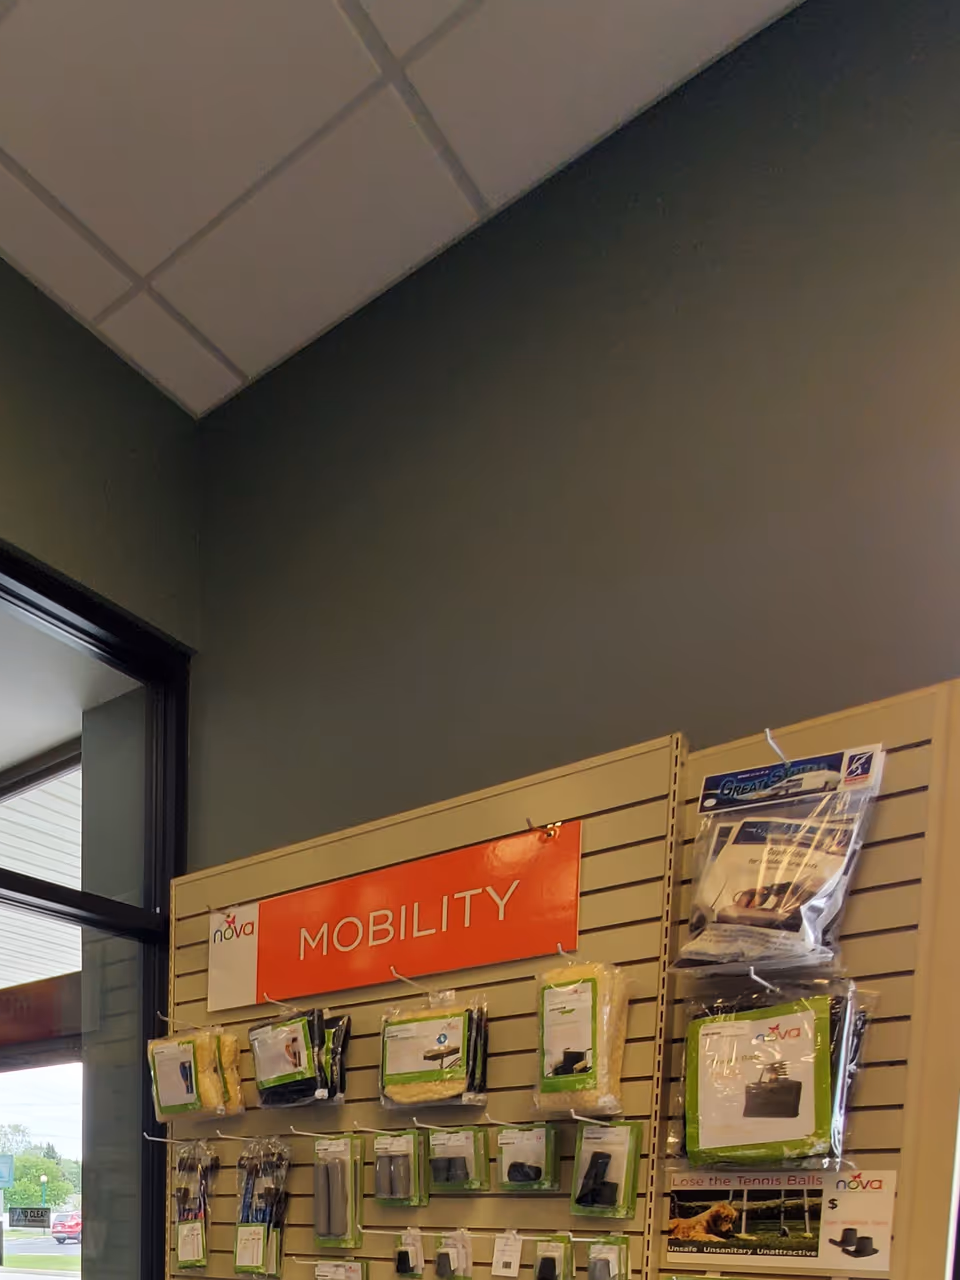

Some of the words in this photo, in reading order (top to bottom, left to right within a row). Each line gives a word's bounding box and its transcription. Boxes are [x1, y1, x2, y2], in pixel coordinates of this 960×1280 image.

[299, 880, 520, 960] MOBILITY
[213, 918, 254, 945] nova
[672, 1174, 704, 1187] Lose
[709, 1175, 731, 1187] the
[737, 1175, 782, 1186] Tennis
[787, 1175, 823, 1186] Balls
[836, 1177, 883, 1191] nova
[828, 1198, 838, 1210] $
[668, 1245, 697, 1253] Unsafe
[703, 1246, 753, 1256] Unsanitary
[757, 1247, 817, 1257] Unattractive
